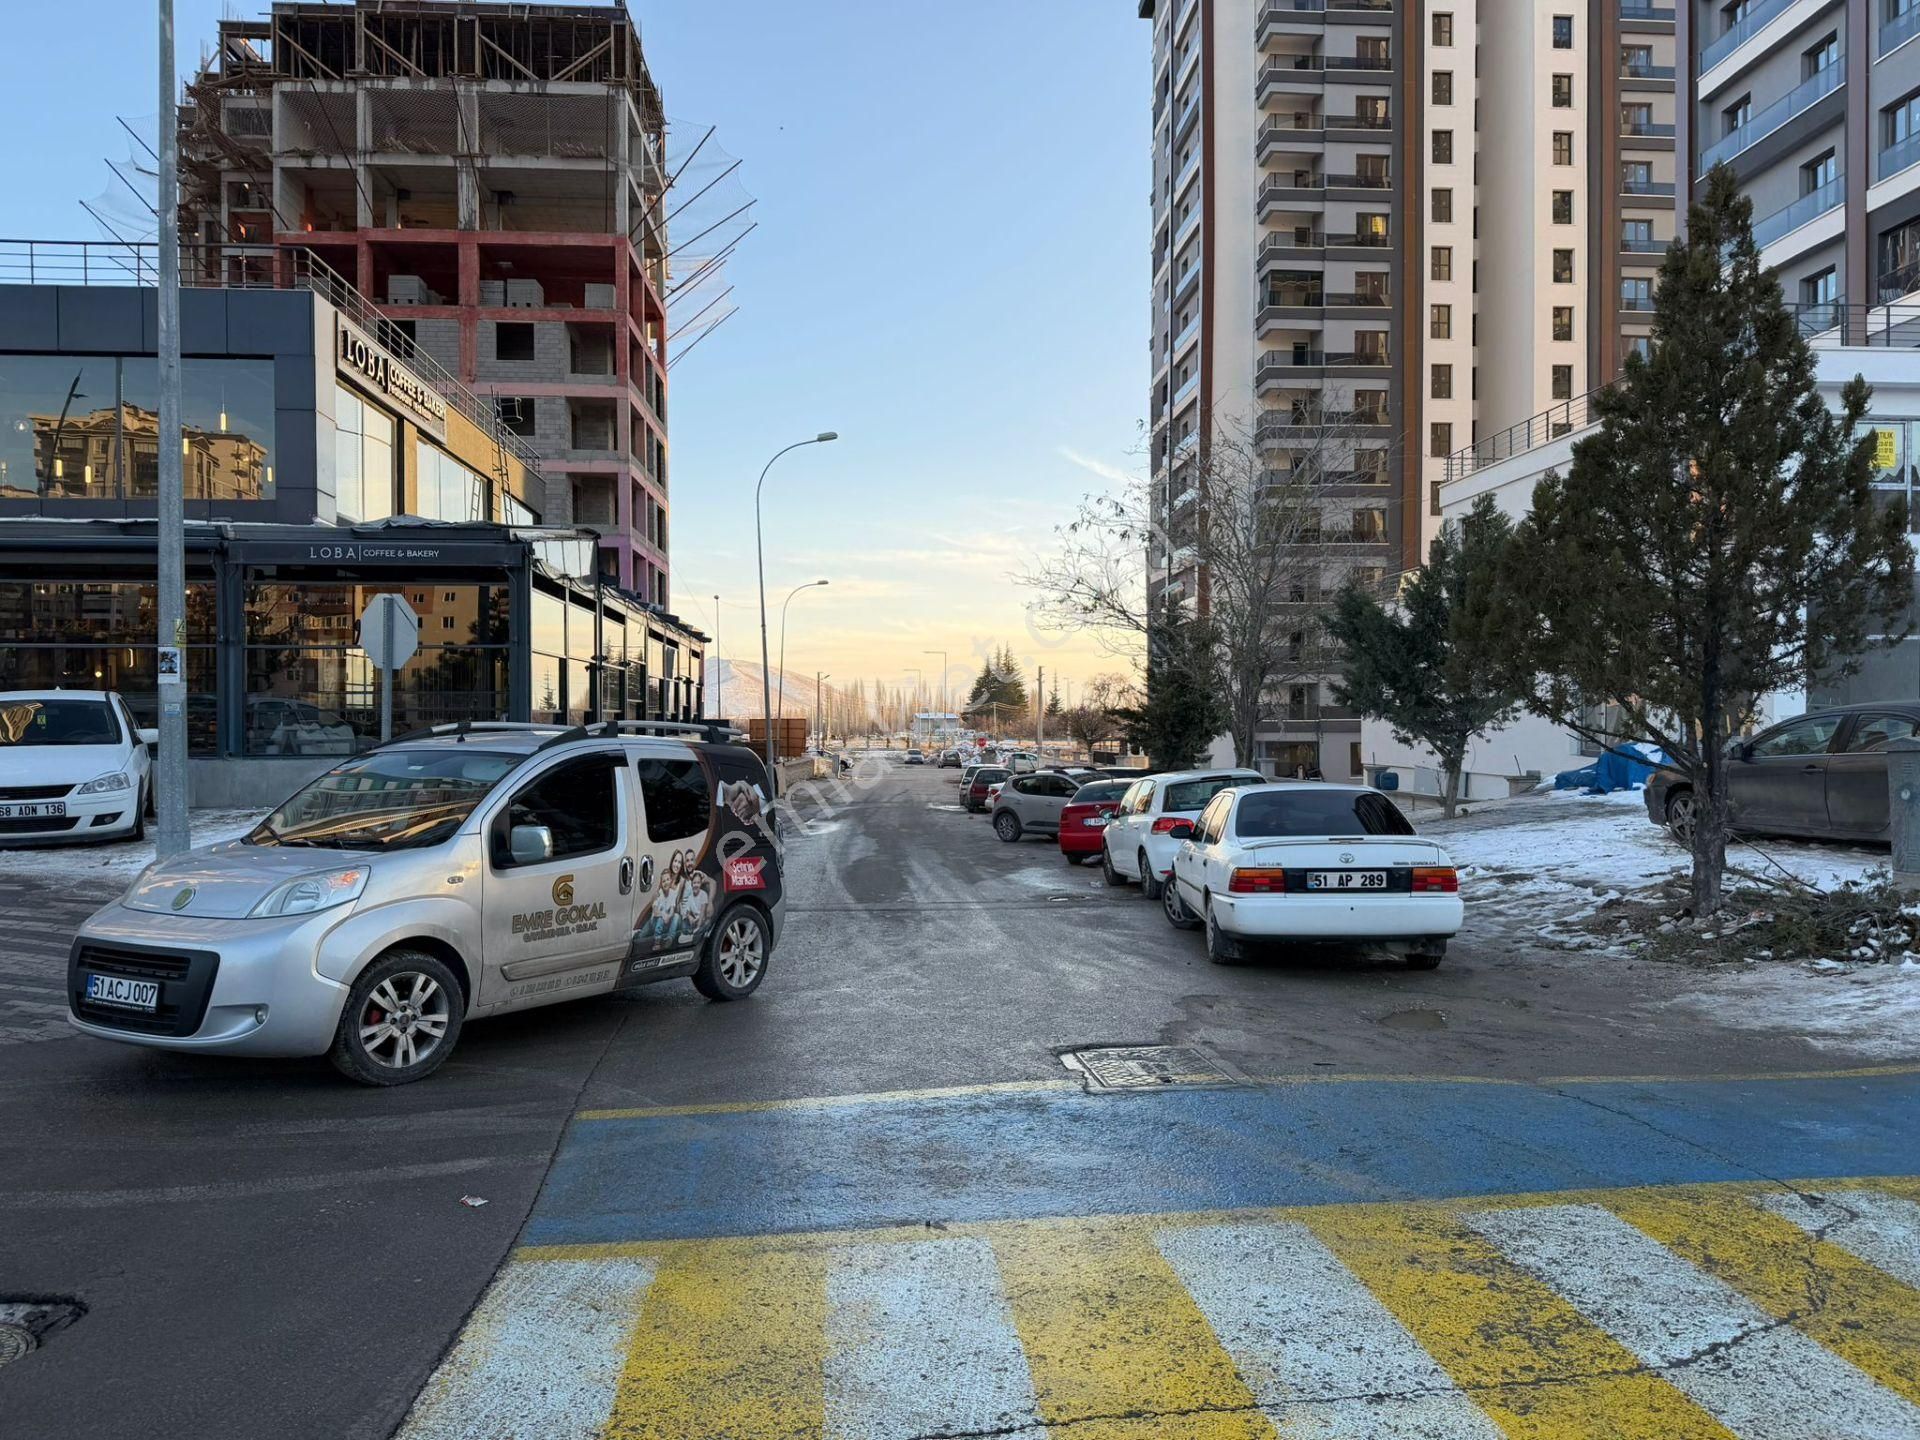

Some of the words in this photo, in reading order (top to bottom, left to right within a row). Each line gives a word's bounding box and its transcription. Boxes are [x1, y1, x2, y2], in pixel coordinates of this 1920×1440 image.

[343, 330, 386, 387] LOBA
[390, 365, 417, 399] COFFEE
[310, 546, 356, 559] LOBA
[363, 549, 396, 558] COFFEE
[397, 549, 405, 558] &
[406, 549, 440, 558] BAKERY
[0, 806, 11, 817] 68
[19, 805, 38, 816] ADN
[45, 804, 64, 815] 136
[1314, 874, 1328, 887] 51
[1337, 874, 1353, 887] AP
[1360, 874, 1384, 887] 289
[512, 909, 554, 934] EMRE
[93, 976, 105, 998] 51
[106, 979, 132, 1001] ACJ
[133, 983, 157, 1005] 007
